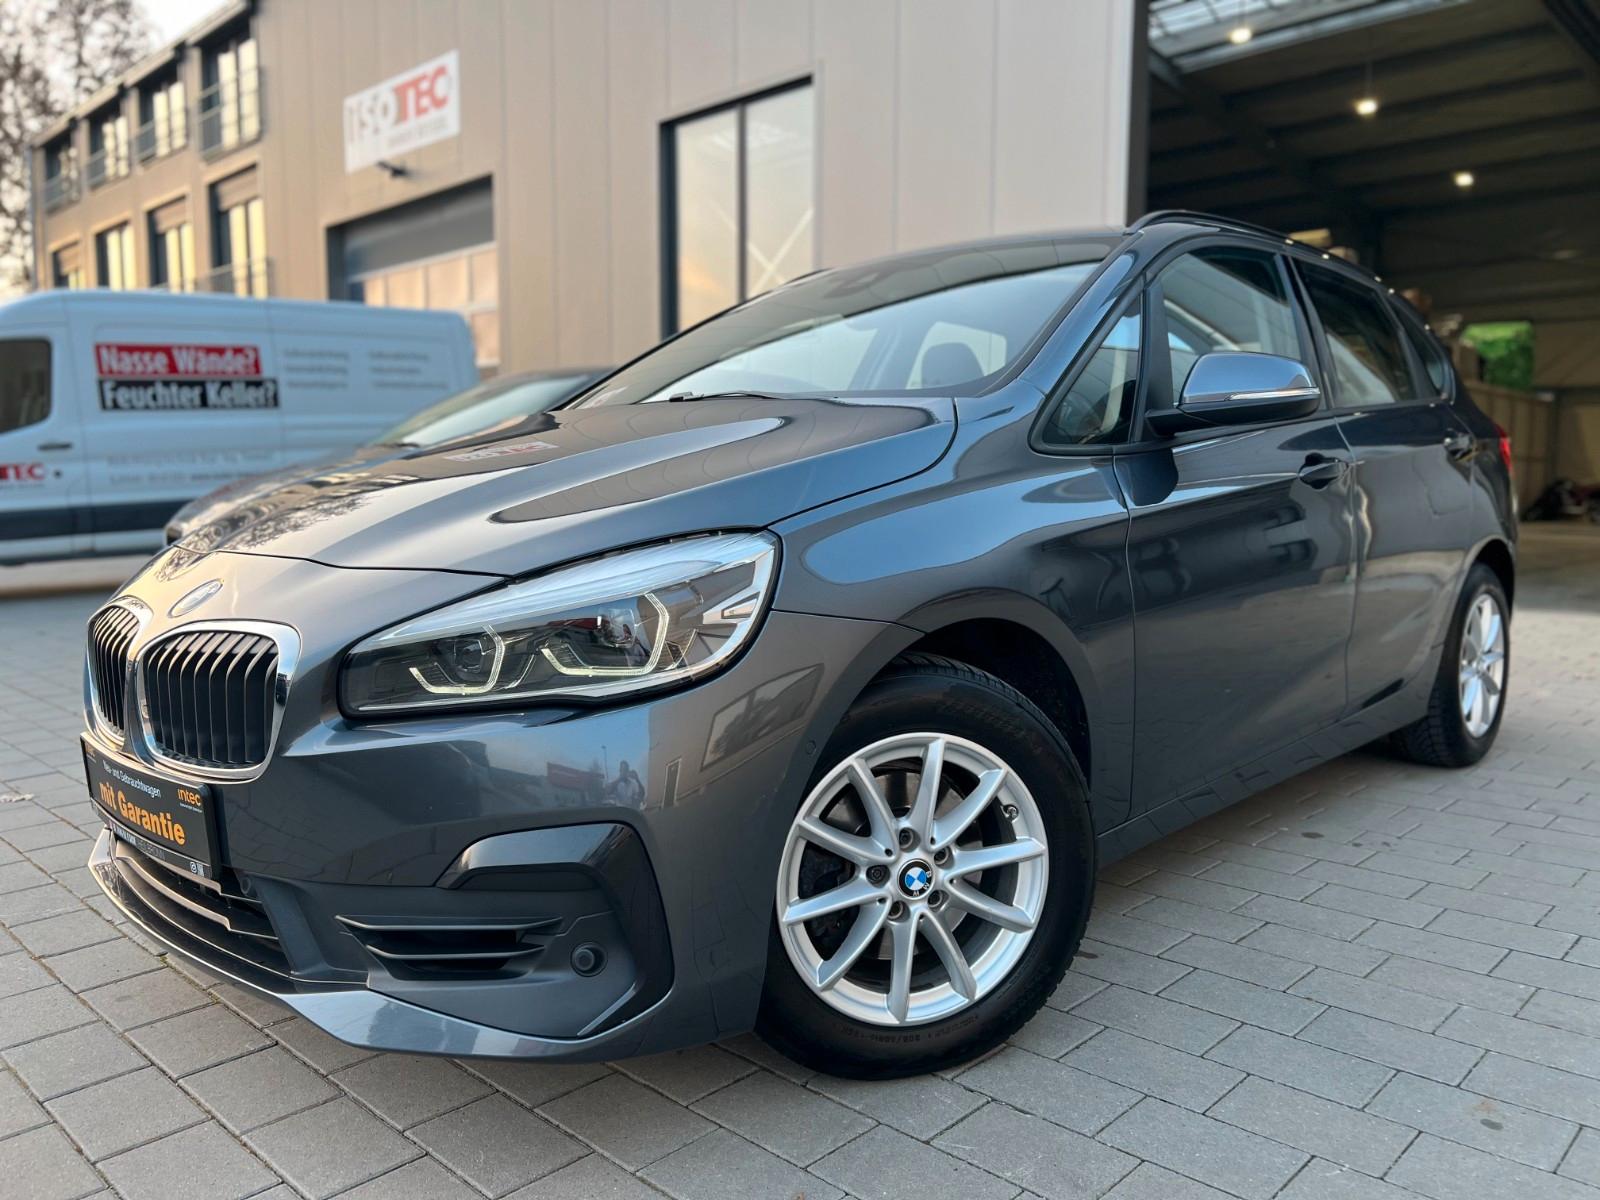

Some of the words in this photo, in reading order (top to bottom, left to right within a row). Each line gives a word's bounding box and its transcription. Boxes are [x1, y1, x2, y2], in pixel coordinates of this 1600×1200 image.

[100, 345, 168, 374] Nasse
[171, 346, 257, 375] Wände?
[102, 381, 203, 409] Feuchter
[205, 381, 276, 408] Keller?
[99, 782, 117, 811] mit
[117, 790, 186, 845] Garantie
